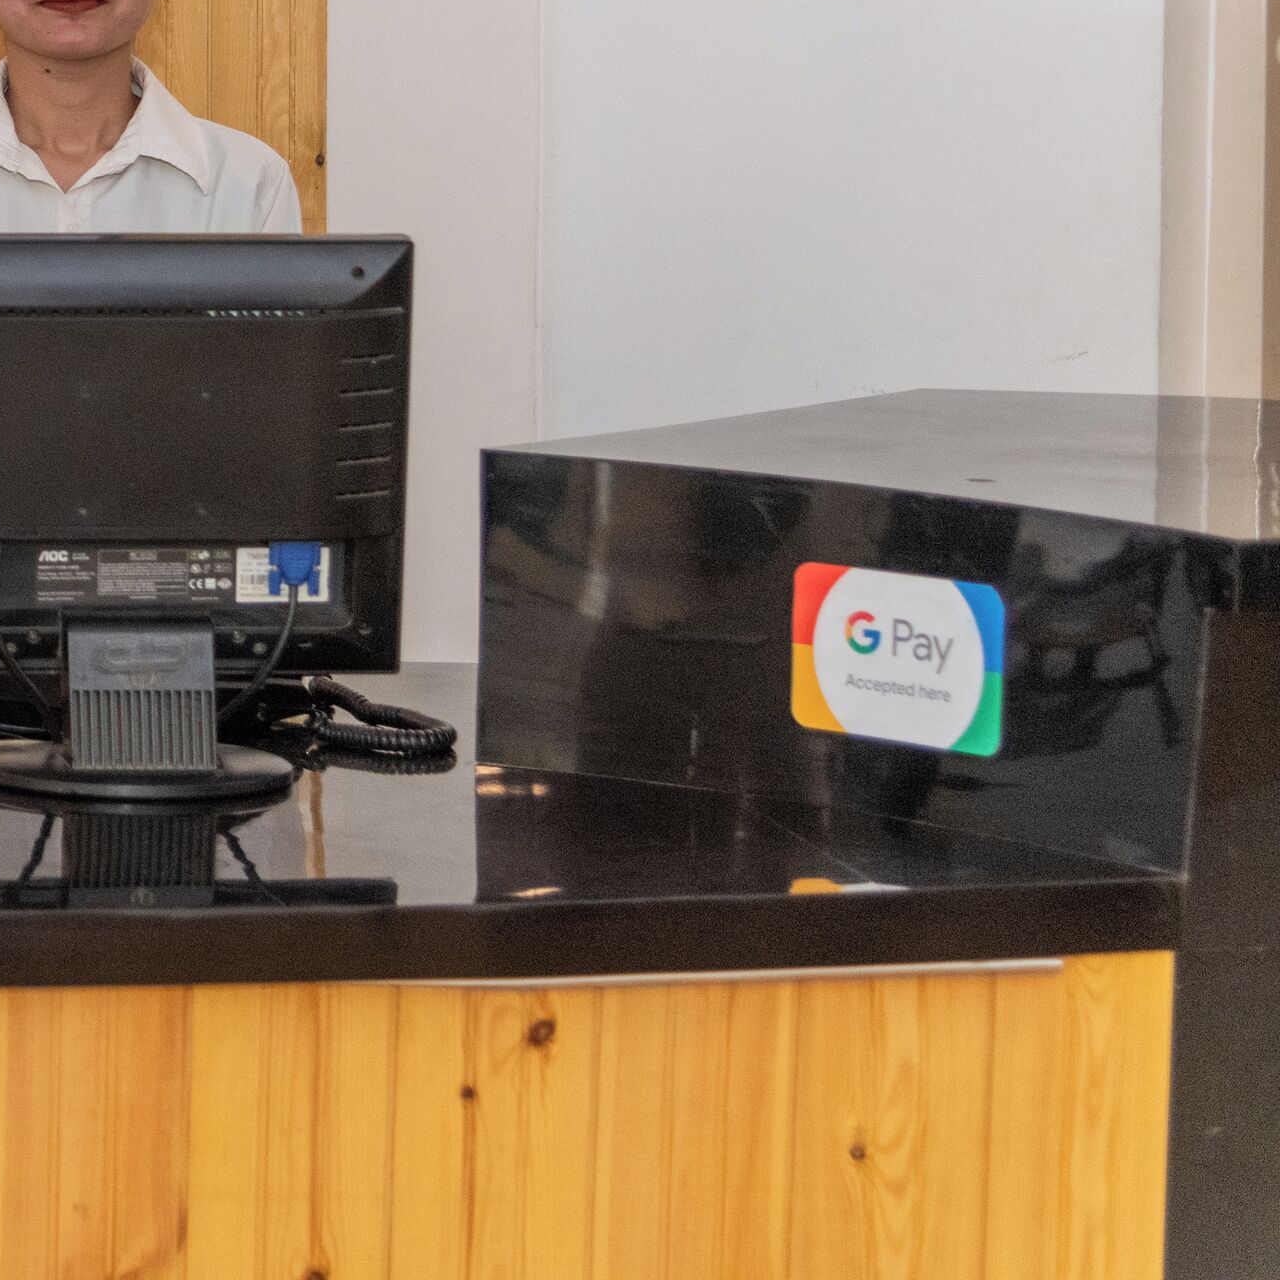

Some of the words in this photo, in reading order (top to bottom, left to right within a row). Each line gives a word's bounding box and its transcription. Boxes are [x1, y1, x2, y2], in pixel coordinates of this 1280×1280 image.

[844, 610, 881, 654] G
[891, 618, 953, 675] Pay
[845, 673, 916, 697] Accepted
[918, 685, 952, 703] here
